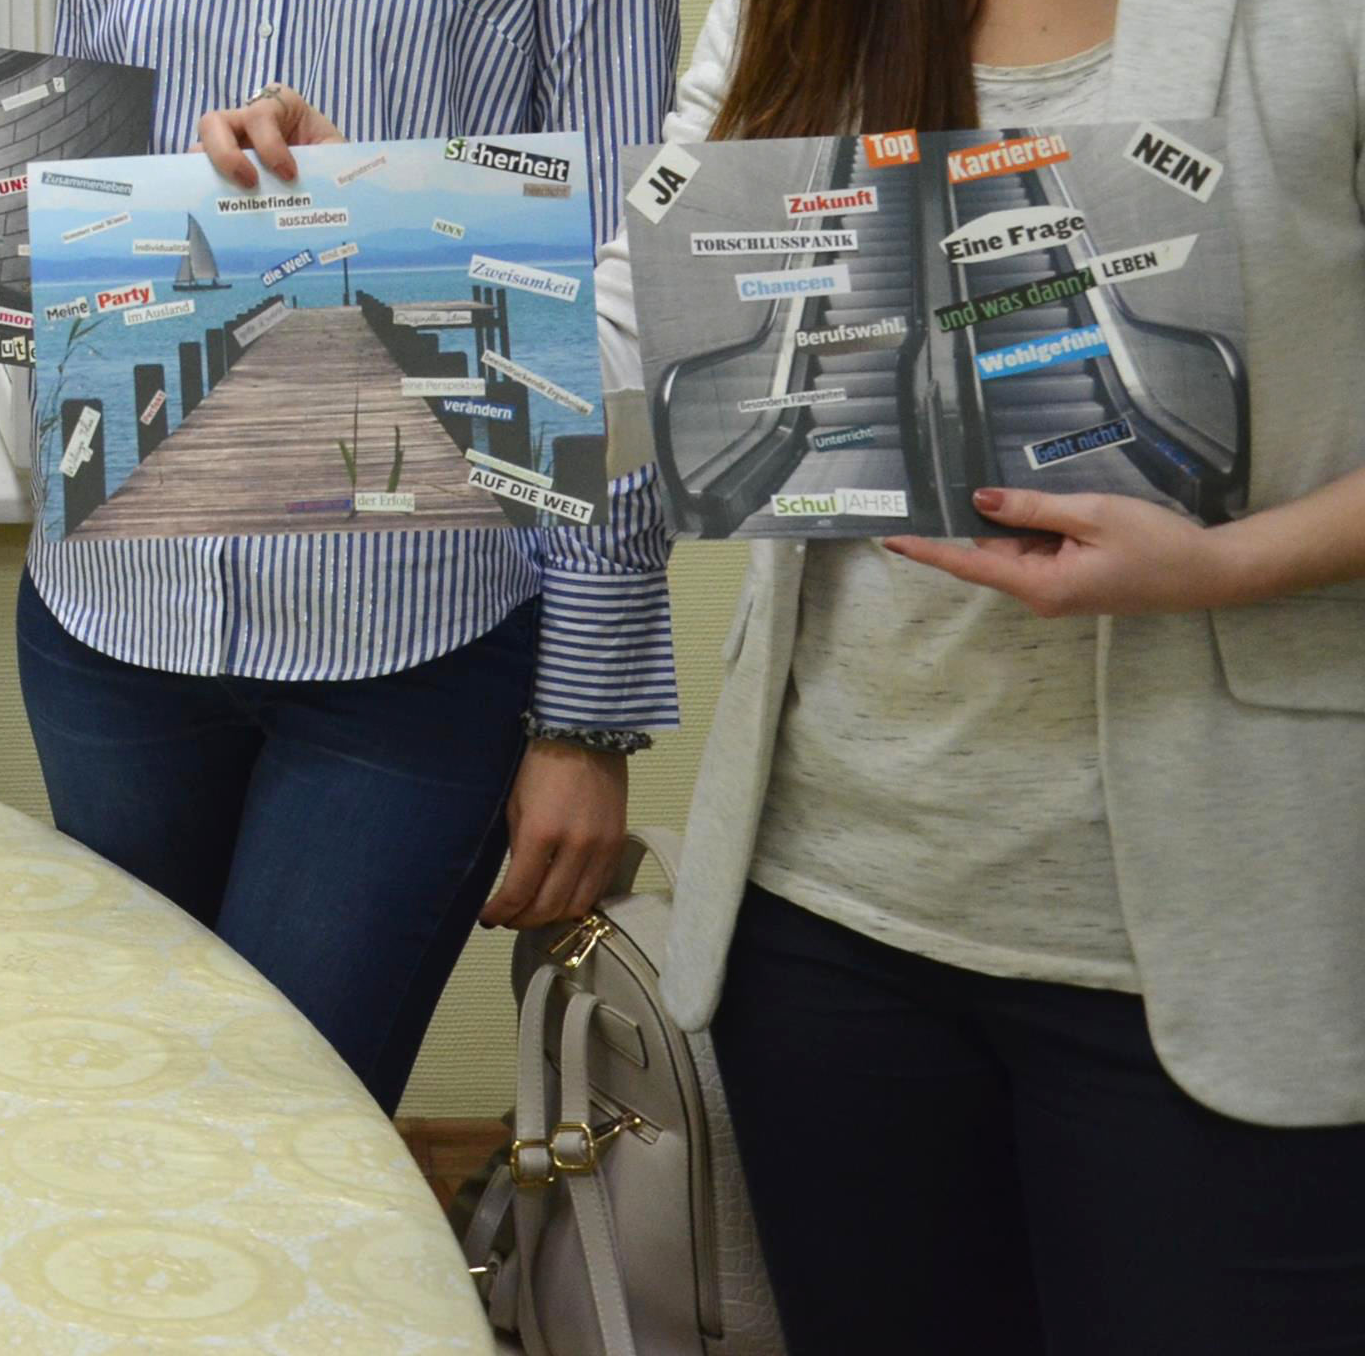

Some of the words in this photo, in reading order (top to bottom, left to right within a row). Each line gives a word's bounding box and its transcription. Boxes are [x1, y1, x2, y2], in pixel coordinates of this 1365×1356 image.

[446, 141, 567, 180] Sicherheit
[870, 135, 914, 160] Top
[949, 136, 1066, 180] Karrieren
[1133, 133, 1211, 192] NEIN
[44, 174, 132, 194] Zusammenleben
[648, 166, 687, 205] JA
[218, 196, 310, 212] Wohlbefinden
[789, 191, 873, 213] Zukunft
[279, 212, 346, 226] auszuleben
[694, 235, 853, 251] TORSCHLUSSPANIK
[946, 236, 1003, 260] Eine
[1007, 216, 1085, 245] Frage
[262, 270, 281, 286] die
[282, 252, 312, 275] Welt
[1102, 252, 1157, 277] LEBEN
[472, 260, 575, 296] Zweisamkeit
[741, 276, 834, 297] Chancen
[46, 302, 88, 320] Meine
[98, 286, 150, 309] Party
[939, 303, 976, 330] und
[981, 293, 1023, 316] was
[1027, 269, 1090, 305] dann?
[127, 309, 142, 322] im
[145, 303, 190, 319] Ausland
[797, 320, 906, 346] Berufswahl.
[980, 329, 1102, 372] Wohlgefühl
[444, 399, 512, 420] verändern
[741, 395, 788, 409] Besondere
[815, 429, 873, 447] Unterricht
[1034, 440, 1074, 463] Geht
[358, 496, 374, 507] der
[379, 494, 413, 509] Erfolg
[471, 472, 504, 489] AUF
[510, 482, 537, 503] DIE
[541, 494, 590, 519] WELT
[776, 496, 836, 513] Schul
